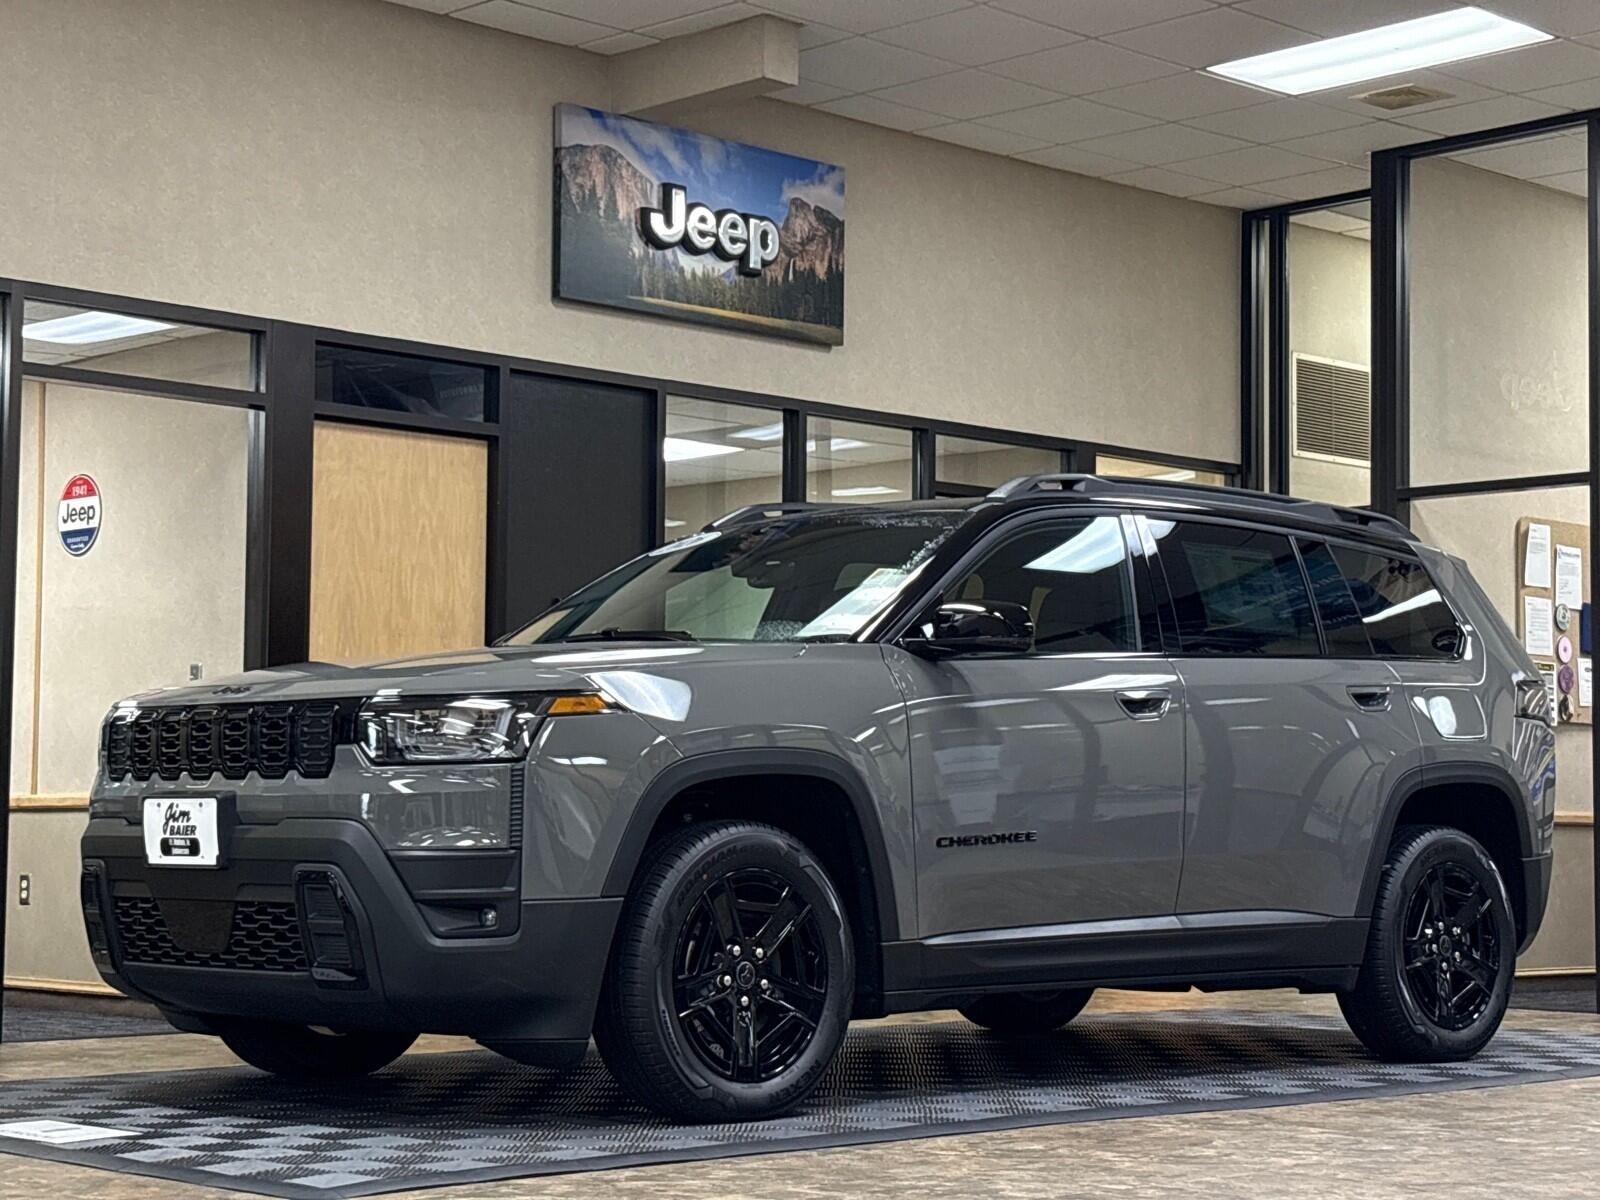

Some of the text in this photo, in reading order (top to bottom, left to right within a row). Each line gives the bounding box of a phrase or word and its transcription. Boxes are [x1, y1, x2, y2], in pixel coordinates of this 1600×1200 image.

[639, 183, 780, 277] Jeep
[62, 503, 96, 526] Jeep
[162, 802, 192, 836] Jim
[169, 825, 197, 836] BAIER
[936, 831, 1037, 848] CHEROKEE
